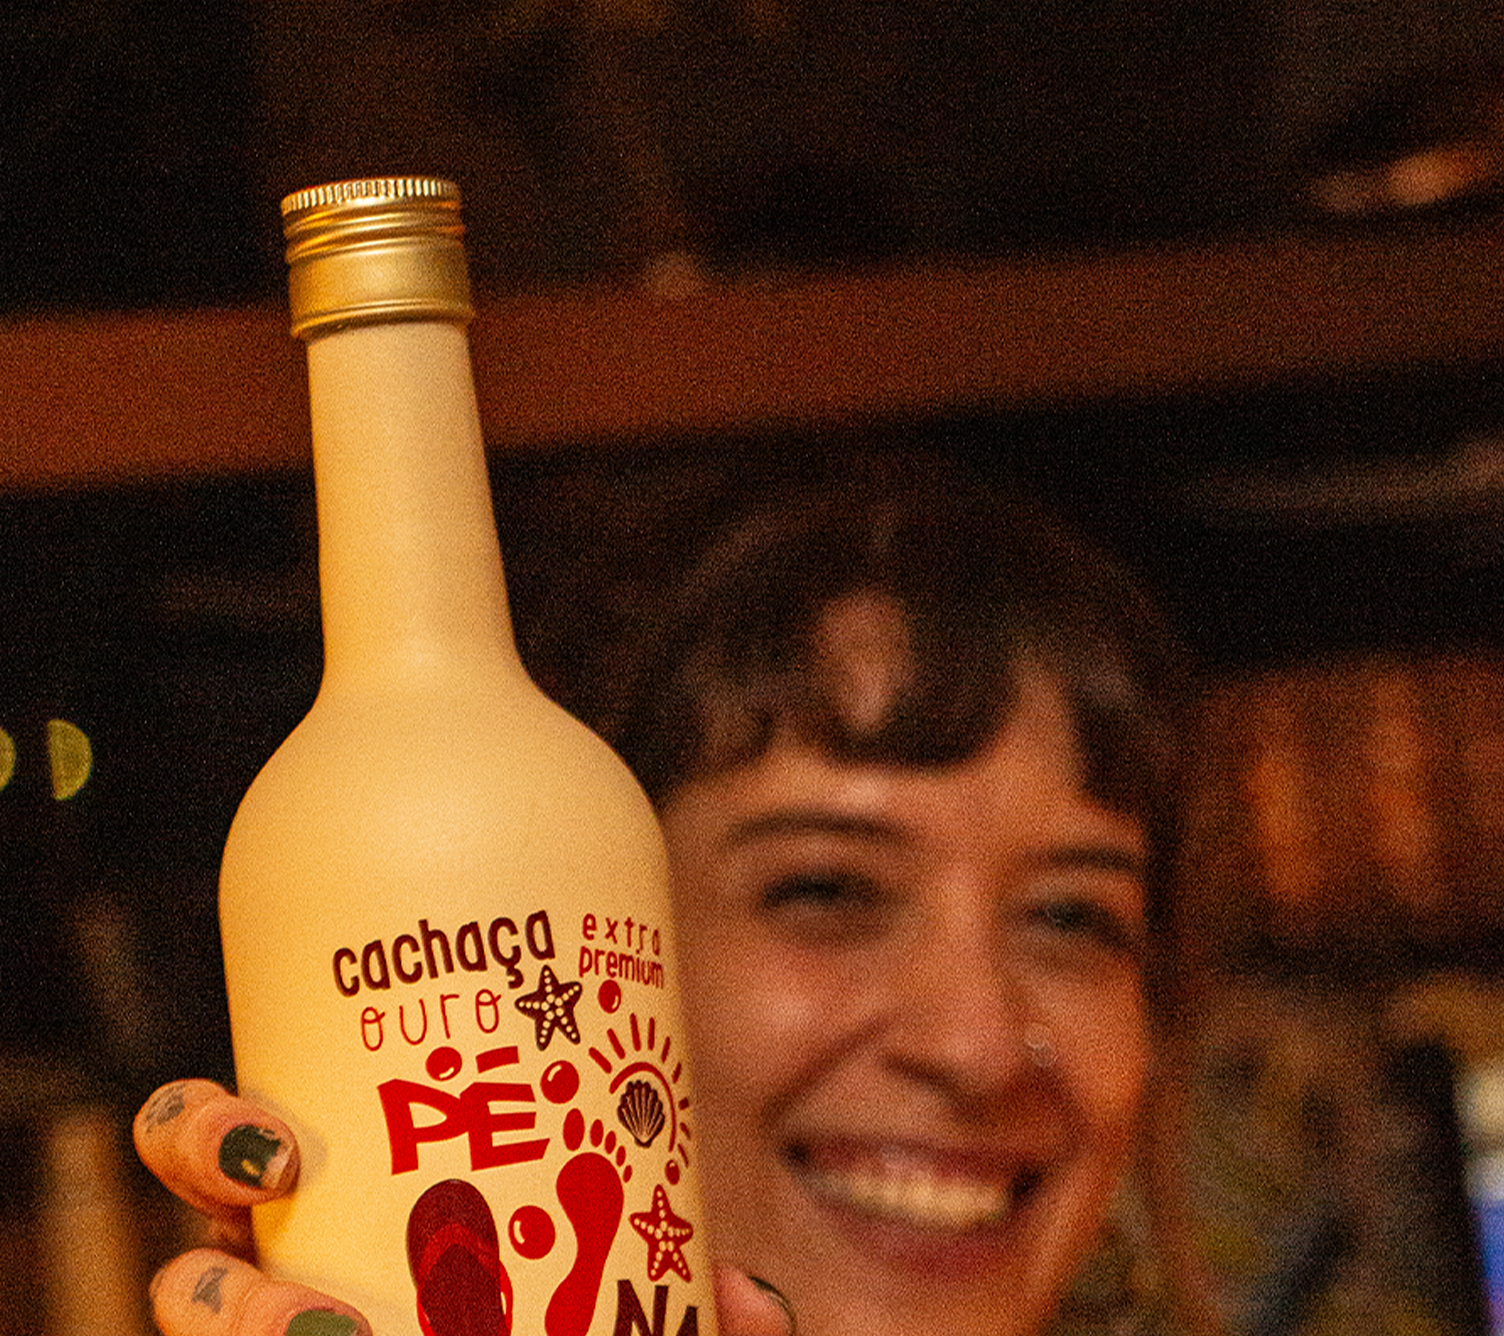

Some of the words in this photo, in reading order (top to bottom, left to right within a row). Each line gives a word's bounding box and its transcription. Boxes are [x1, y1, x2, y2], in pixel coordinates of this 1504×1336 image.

[332, 910, 556, 998] cachaça
[582, 913, 661, 956] extra
[579, 945, 665, 990] premium
[361, 989, 502, 1052] ouro
[378, 1046, 551, 1175] PÉ
